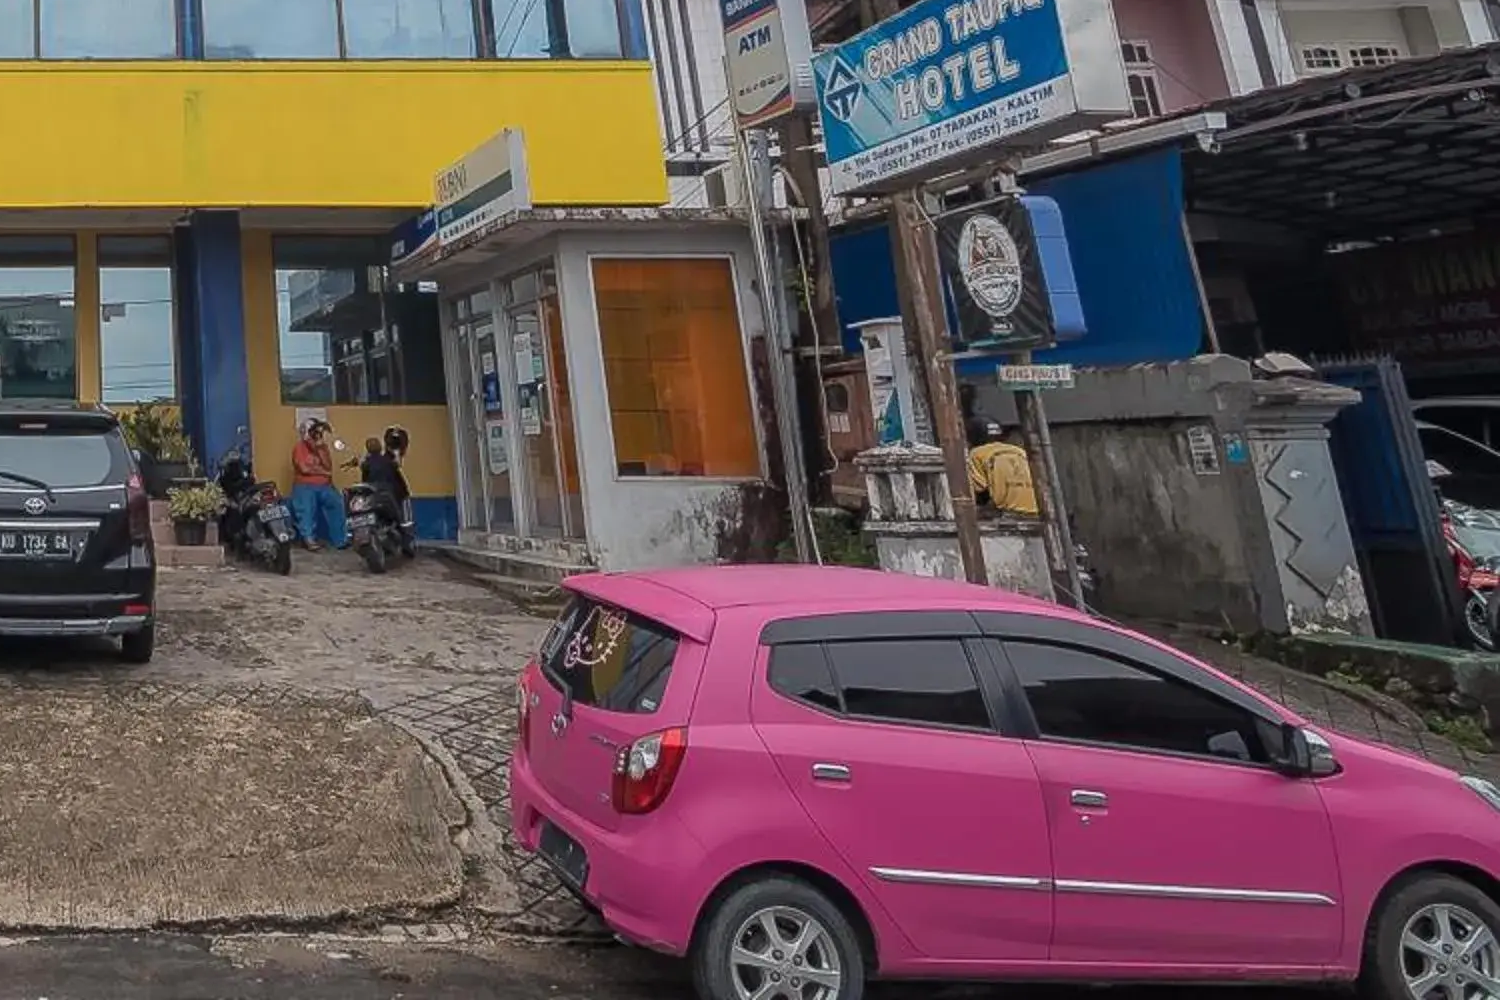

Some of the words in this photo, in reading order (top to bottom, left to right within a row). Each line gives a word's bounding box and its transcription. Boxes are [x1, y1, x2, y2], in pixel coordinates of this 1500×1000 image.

[738, 24, 771, 56] ATM
[863, 15, 943, 81] GRAND
[893, 36, 1021, 121] HOTEL
[944, 106, 997, 133] TARAKAN
[1007, 84, 1054, 111] KALTIM
